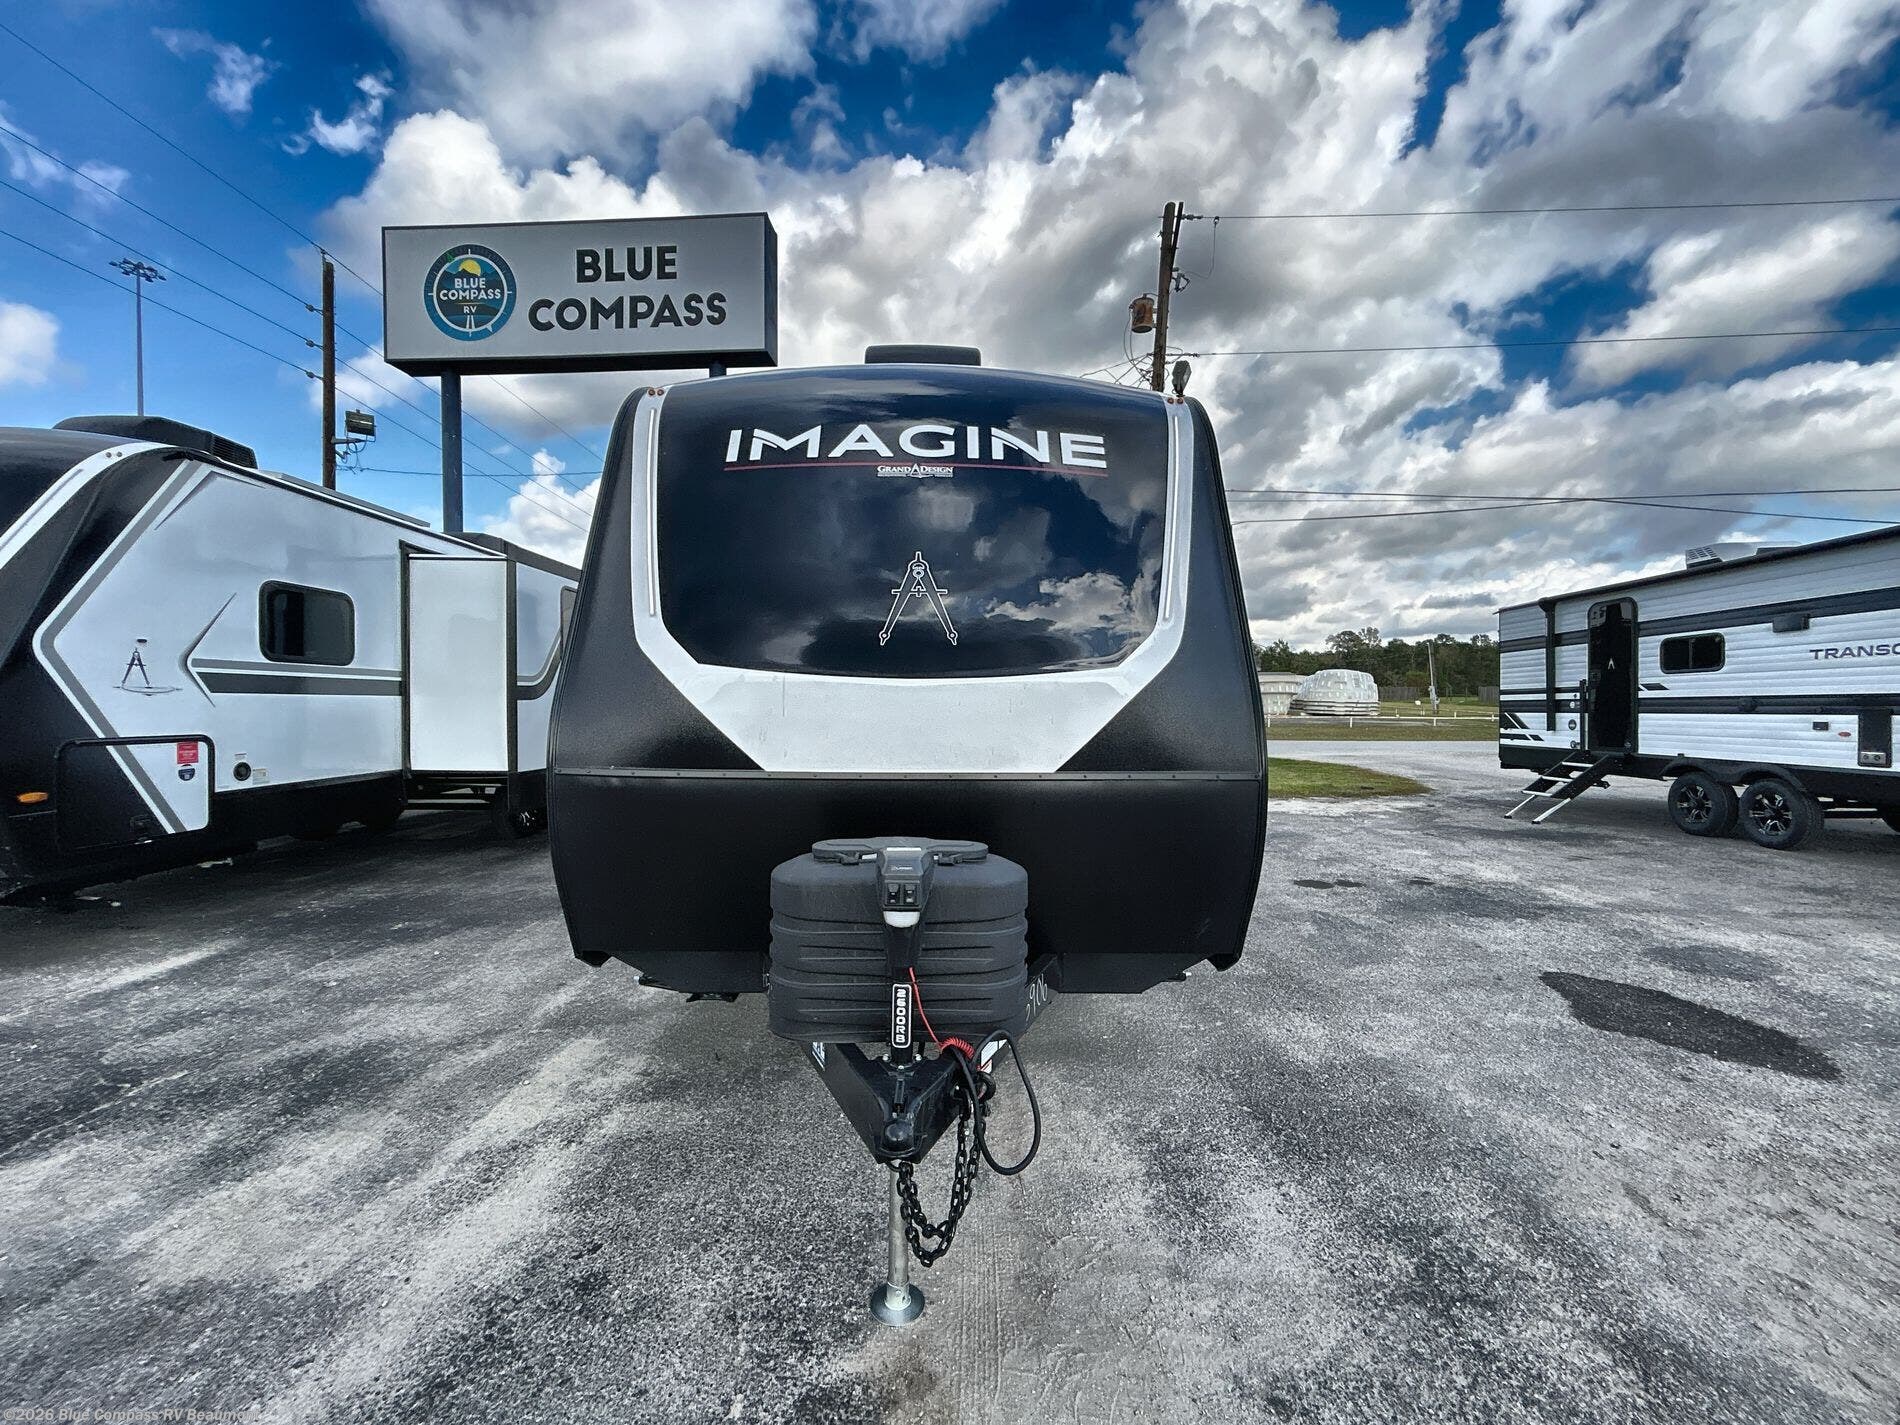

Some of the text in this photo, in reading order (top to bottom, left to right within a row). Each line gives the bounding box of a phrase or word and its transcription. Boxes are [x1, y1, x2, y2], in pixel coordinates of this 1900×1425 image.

[454, 277, 486, 289] BLUE
[576, 245, 678, 283] BLUE
[439, 288, 502, 301] COMPASS
[463, 305, 477, 314] RV
[528, 292, 727, 332] COMPASS
[725, 423, 1108, 469] IMAGINE
[895, 988, 907, 1043] 2600RB
